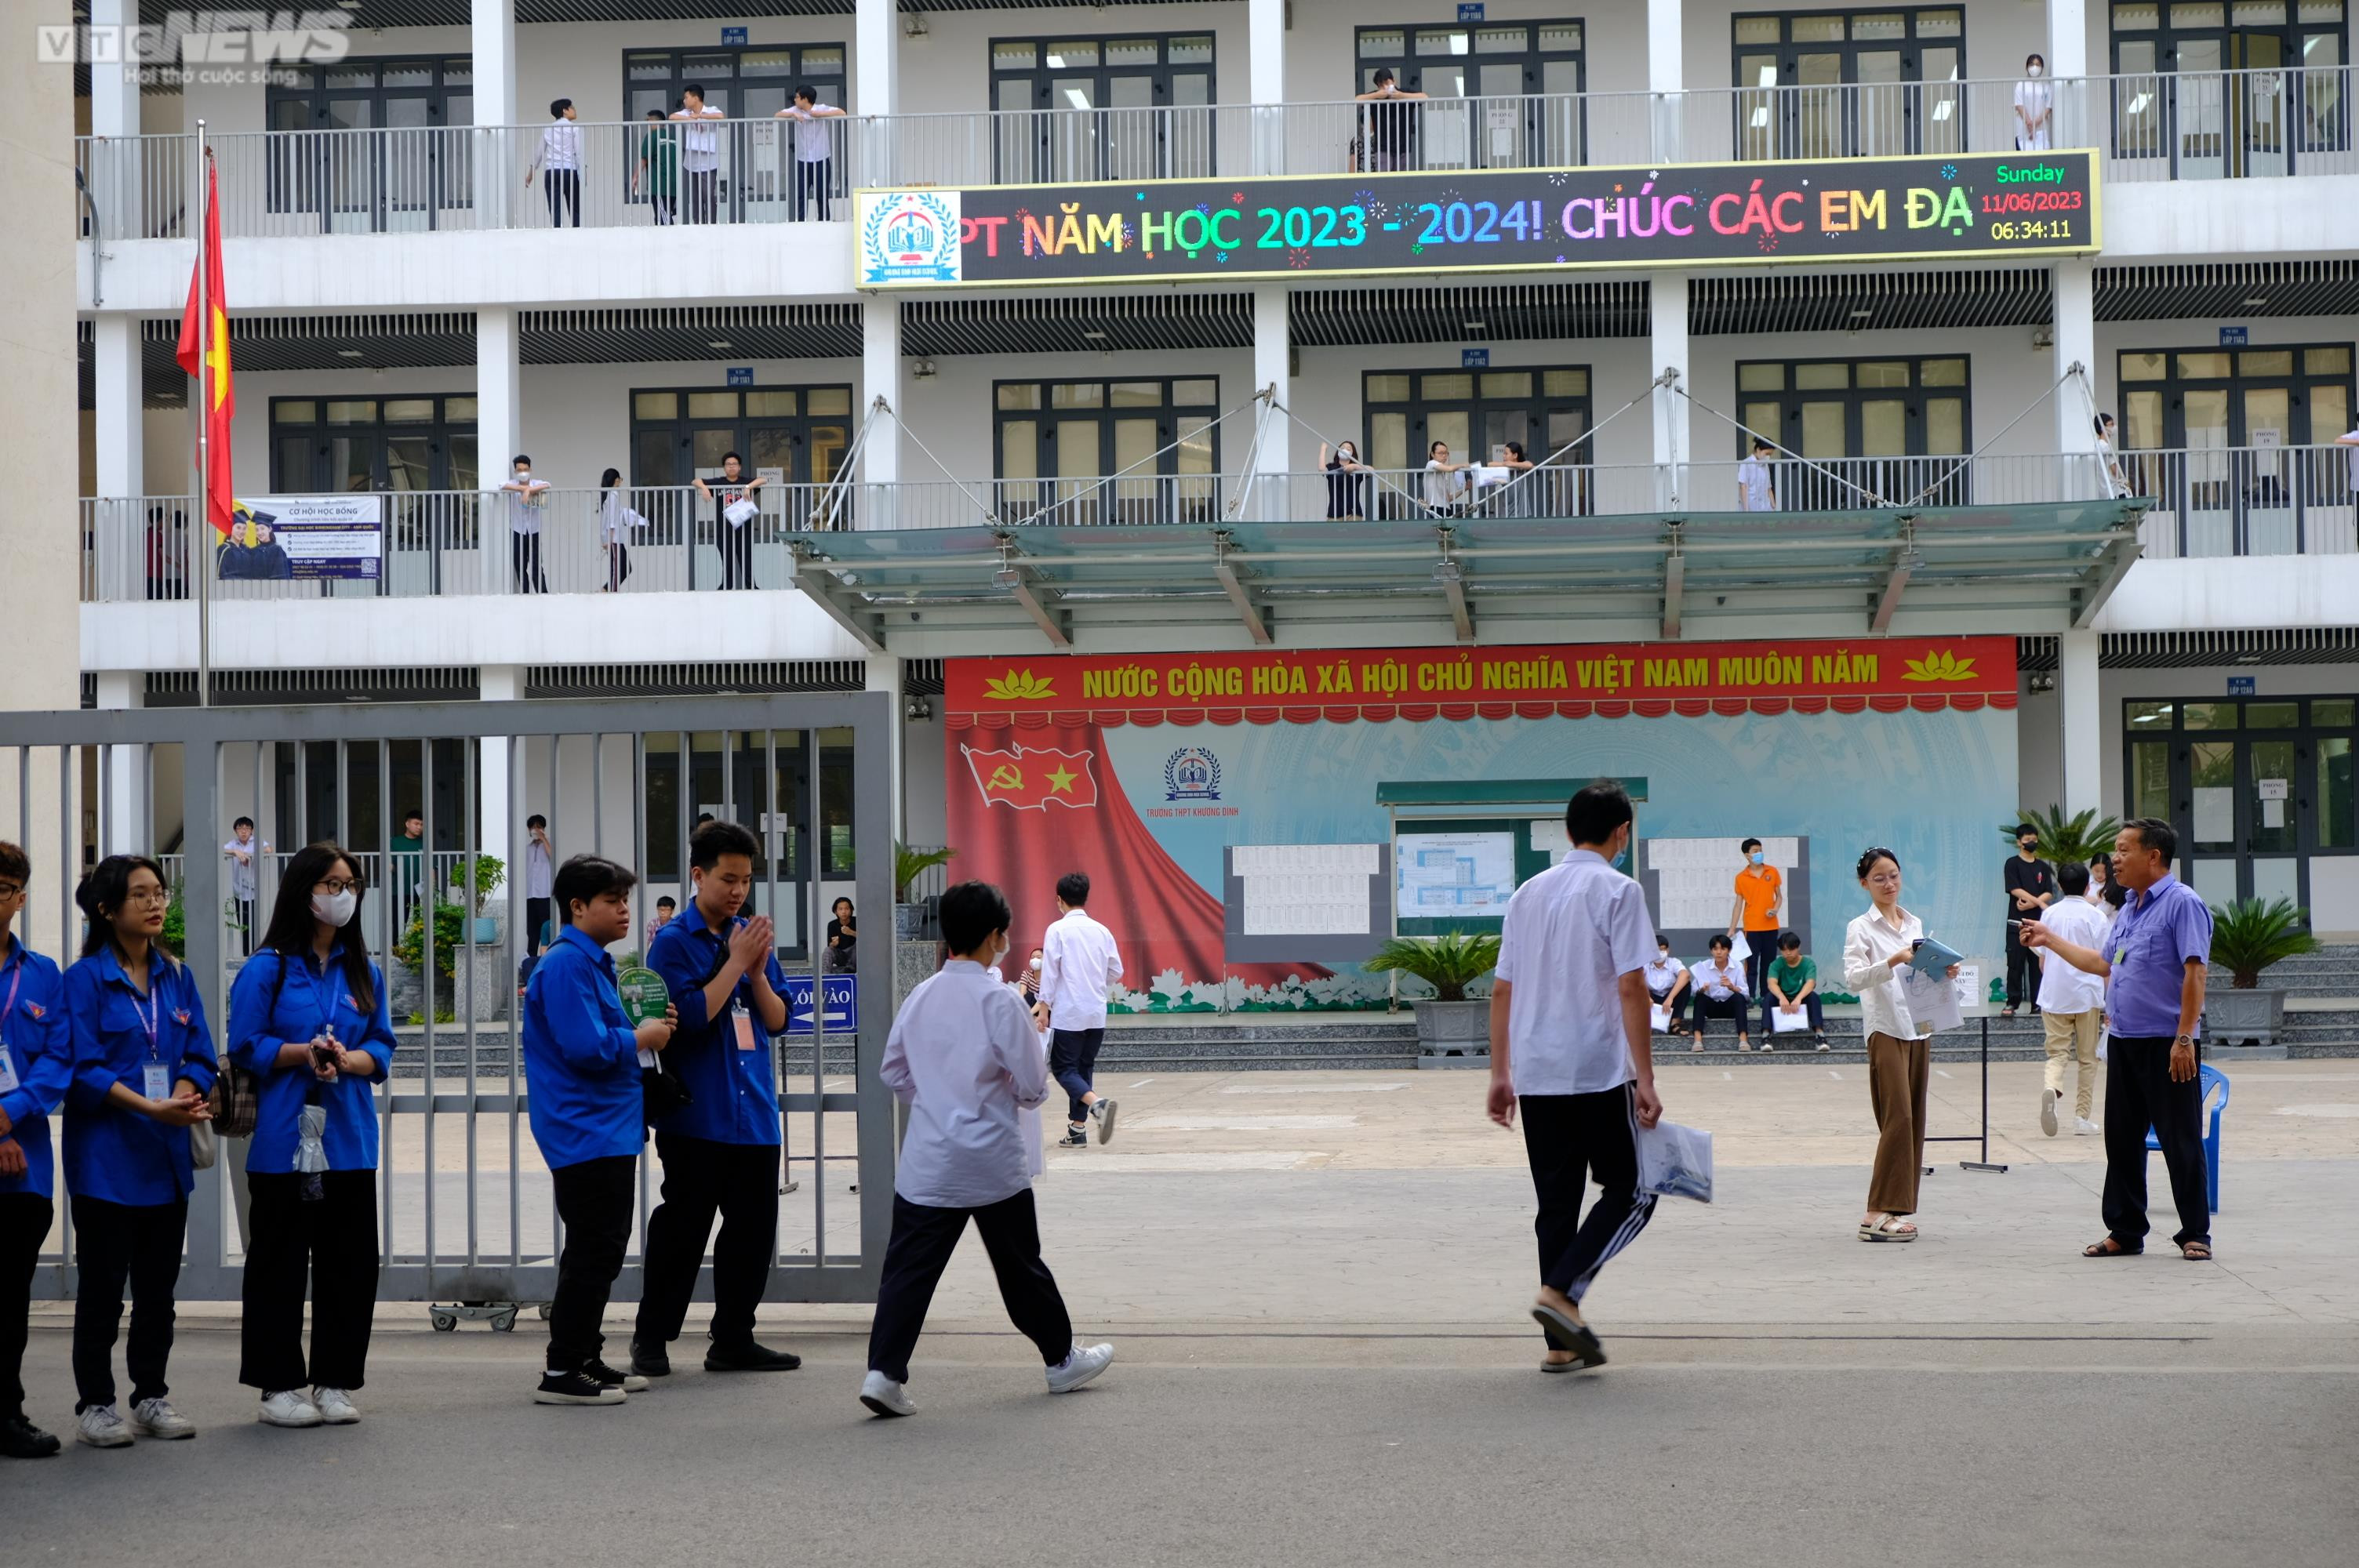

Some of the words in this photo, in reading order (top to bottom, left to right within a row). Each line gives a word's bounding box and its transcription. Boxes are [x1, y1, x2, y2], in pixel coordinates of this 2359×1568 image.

[1996, 162, 2065, 184] Sunday
[1981, 191, 2082, 215] 11/06/2023
[1023, 202, 1123, 257] NĂM
[1141, 209, 1241, 260] HỌC
[1256, 205, 1366, 249] 2023
[1418, 199, 1543, 245] 2024!
[1561, 183, 1696, 239] CHÚC
[1708, 179, 1805, 236] CÁC
[1819, 189, 1888, 232] EM
[1903, 185, 1973, 236] ĐẠ
[1990, 220, 2071, 241] 06:34:11
[302, 506, 316, 517] HỘI
[318, 508, 334, 517] HỌC
[1082, 662, 1159, 699] NƯỚC
[1167, 660, 1243, 702] CỘNG
[1252, 661, 1308, 696] HÒA
[1316, 659, 1355, 694] XÃ
[1361, 658, 1408, 699] HỘI
[1416, 653, 1473, 691] CHỦ
[1481, 654, 1568, 690] NGHĨA
[1576, 653, 1635, 694] VIỆT
[1644, 657, 1710, 688] NAM
[1717, 650, 1803, 686] MUÔN
[1812, 649, 1879, 684] NĂM
[1175, 808, 1191, 818] THPT
[791, 988, 814, 1005] LỐI
[822, 987, 850, 1004] VÀO
